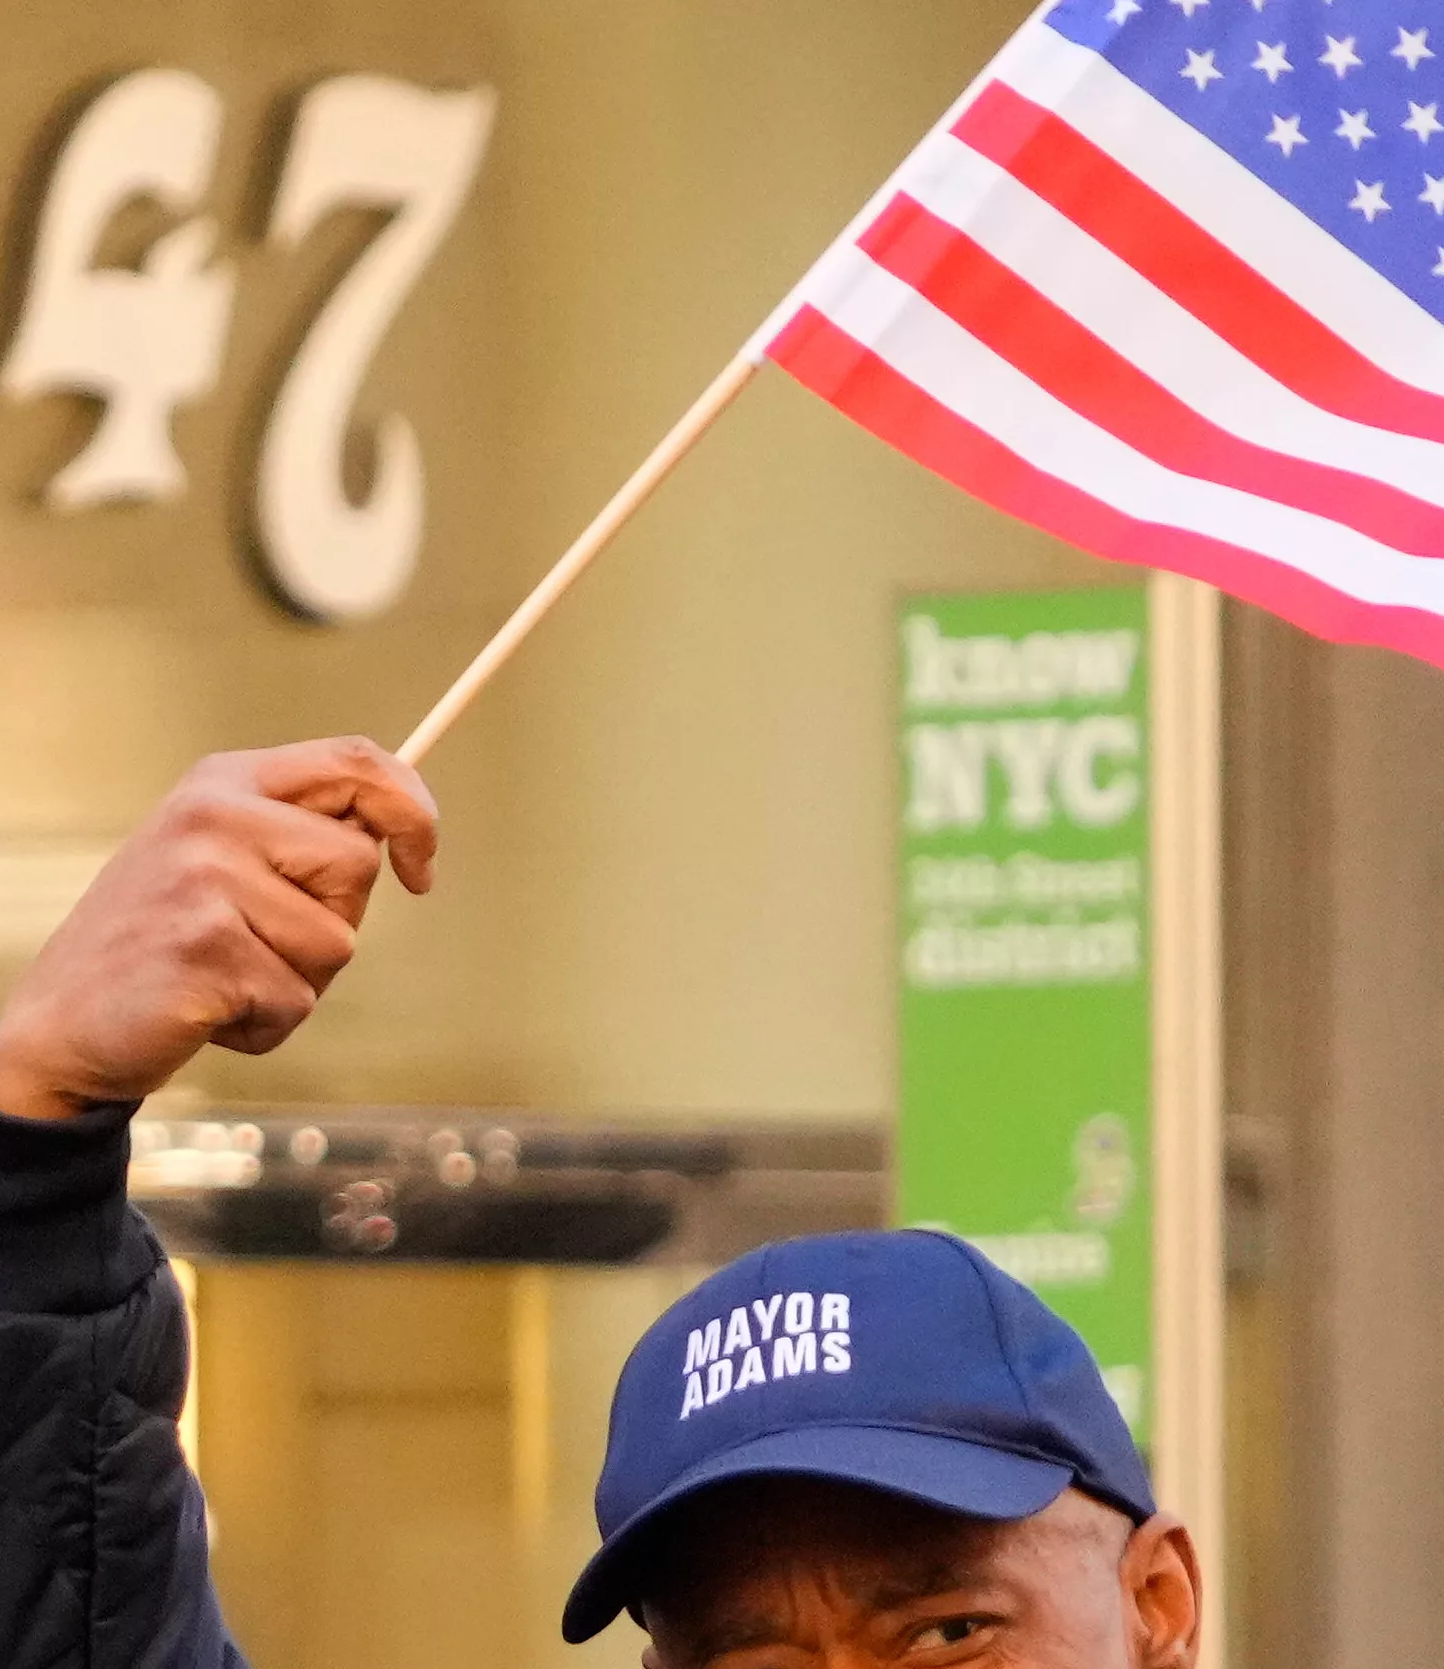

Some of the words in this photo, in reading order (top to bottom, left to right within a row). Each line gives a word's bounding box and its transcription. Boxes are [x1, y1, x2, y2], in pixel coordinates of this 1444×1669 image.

[903, 614, 1140, 705] know
[904, 715, 1141, 830] NYC
[679, 1332, 852, 1420] ADAMS
[682, 1292, 851, 1374] MAYOR
